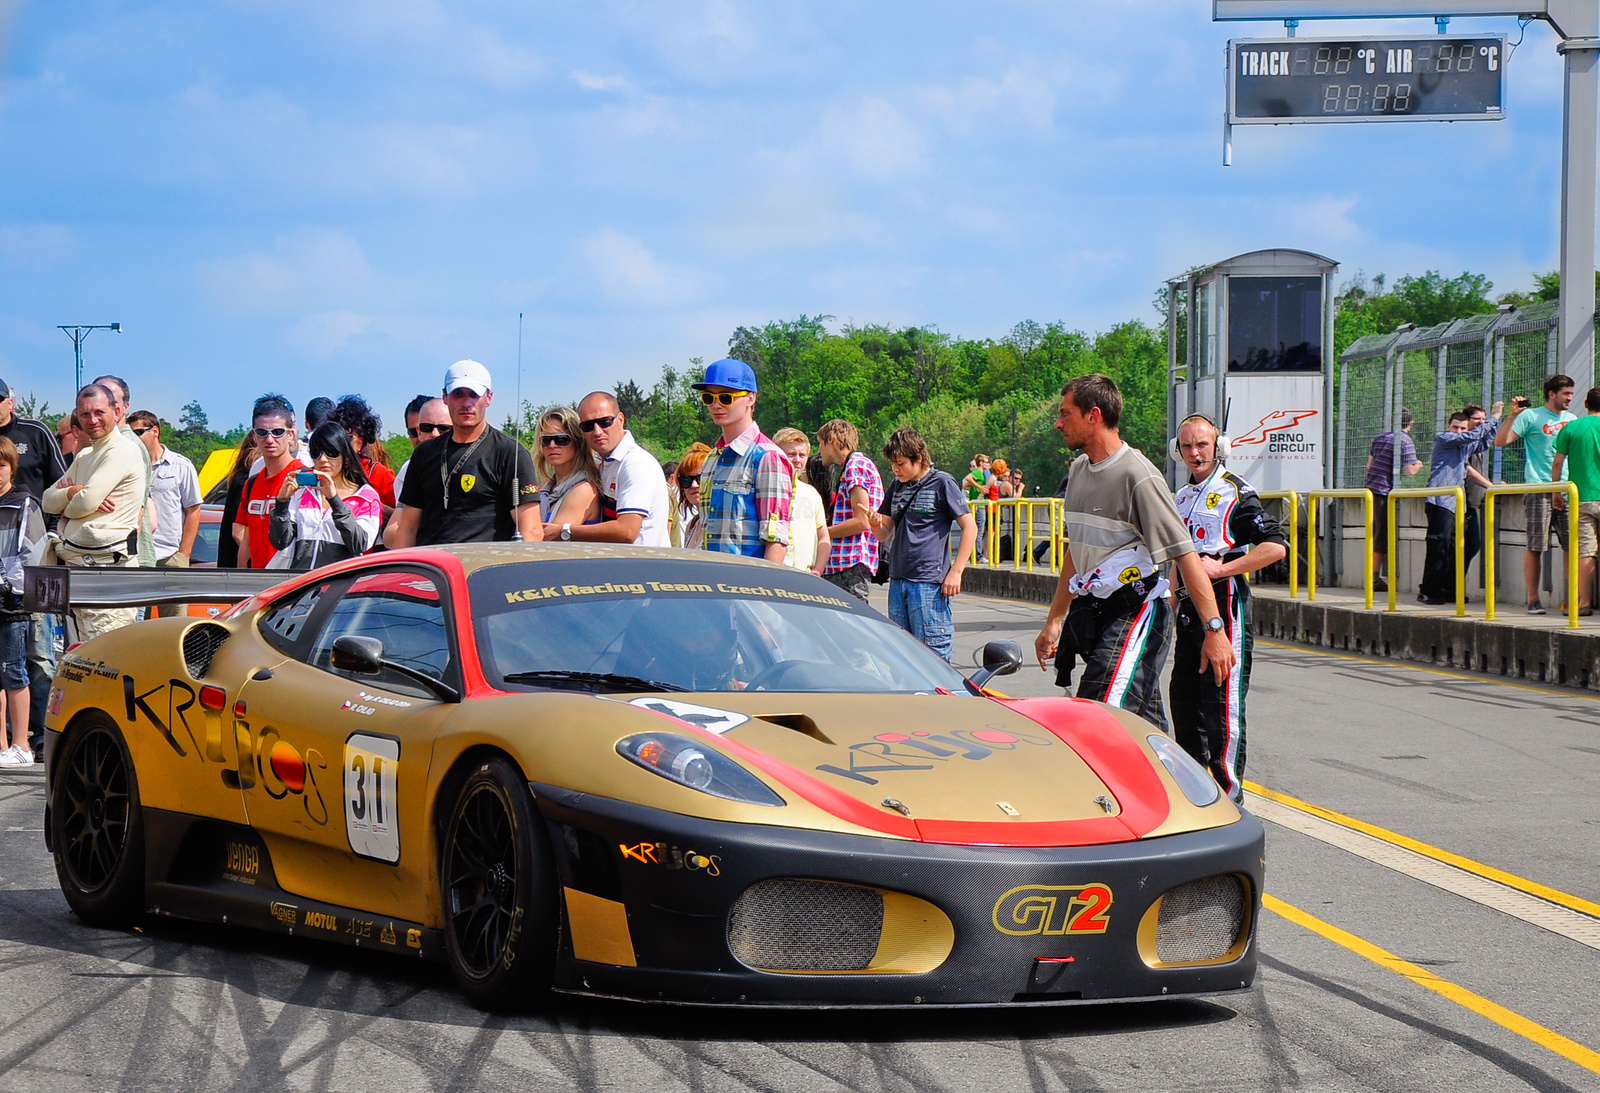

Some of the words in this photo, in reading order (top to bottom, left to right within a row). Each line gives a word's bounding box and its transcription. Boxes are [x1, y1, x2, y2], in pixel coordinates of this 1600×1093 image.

[1241, 51, 1289, 76] TRACK
[1386, 49, 1413, 74] AIR
[1268, 443, 1316, 453] CIRCUIT
[1269, 433, 1304, 443] BRNO
[504, 586, 561, 604] K&K
[561, 583, 646, 595] Racing
[646, 581, 713, 592] Team
[716, 583, 774, 597] Czech
[773, 588, 853, 610] Republic
[351, 754, 384, 824] 31
[304, 911, 337, 931] MOTUL
[992, 882, 1114, 936] GT2
